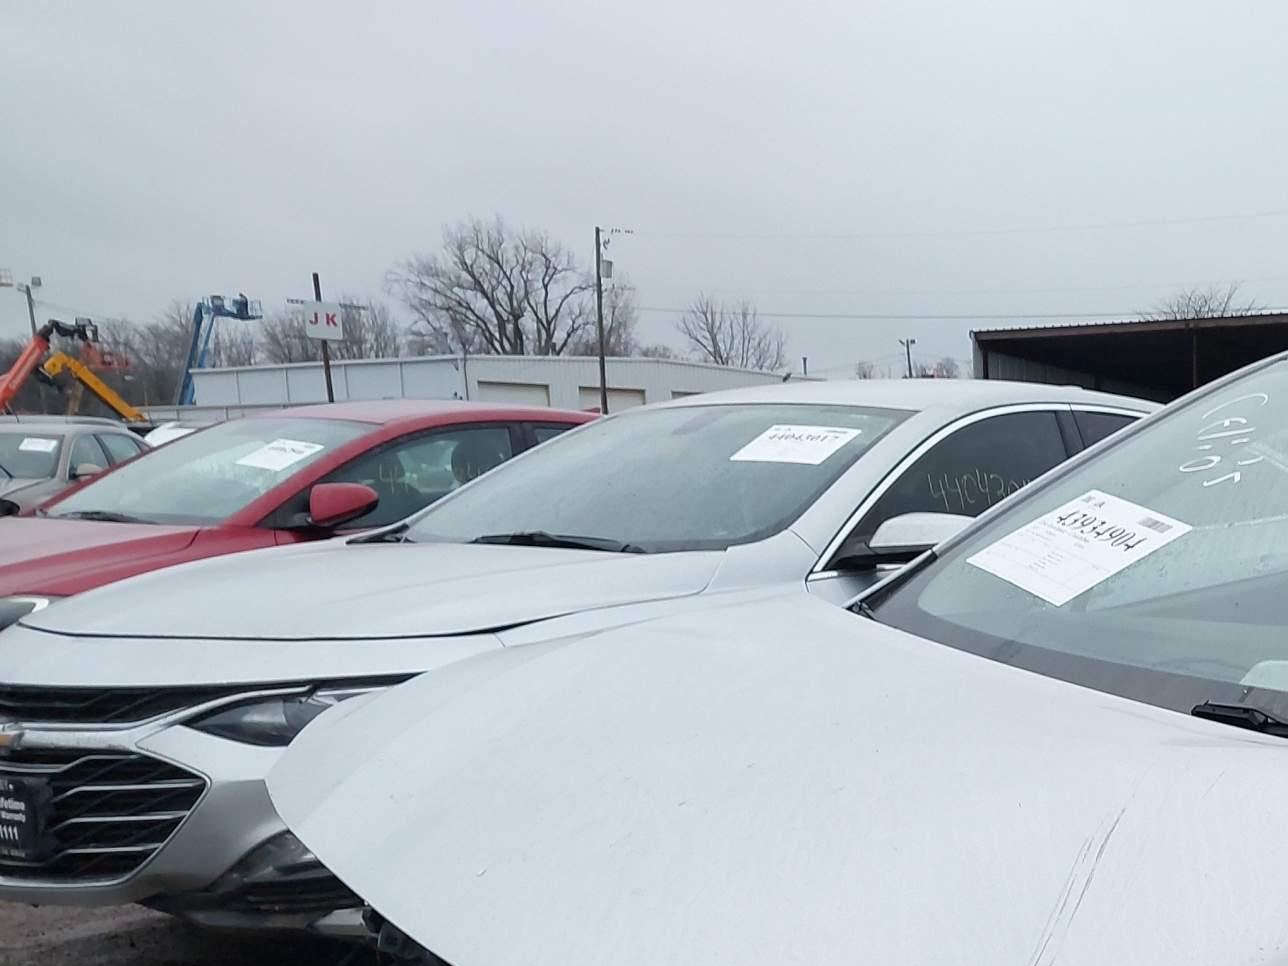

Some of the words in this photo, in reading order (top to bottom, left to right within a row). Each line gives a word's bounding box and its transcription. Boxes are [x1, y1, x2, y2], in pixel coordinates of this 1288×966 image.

[309, 311, 319, 326] J
[325, 312, 338, 328] K
[1056, 510, 1148, 552] 43934904
